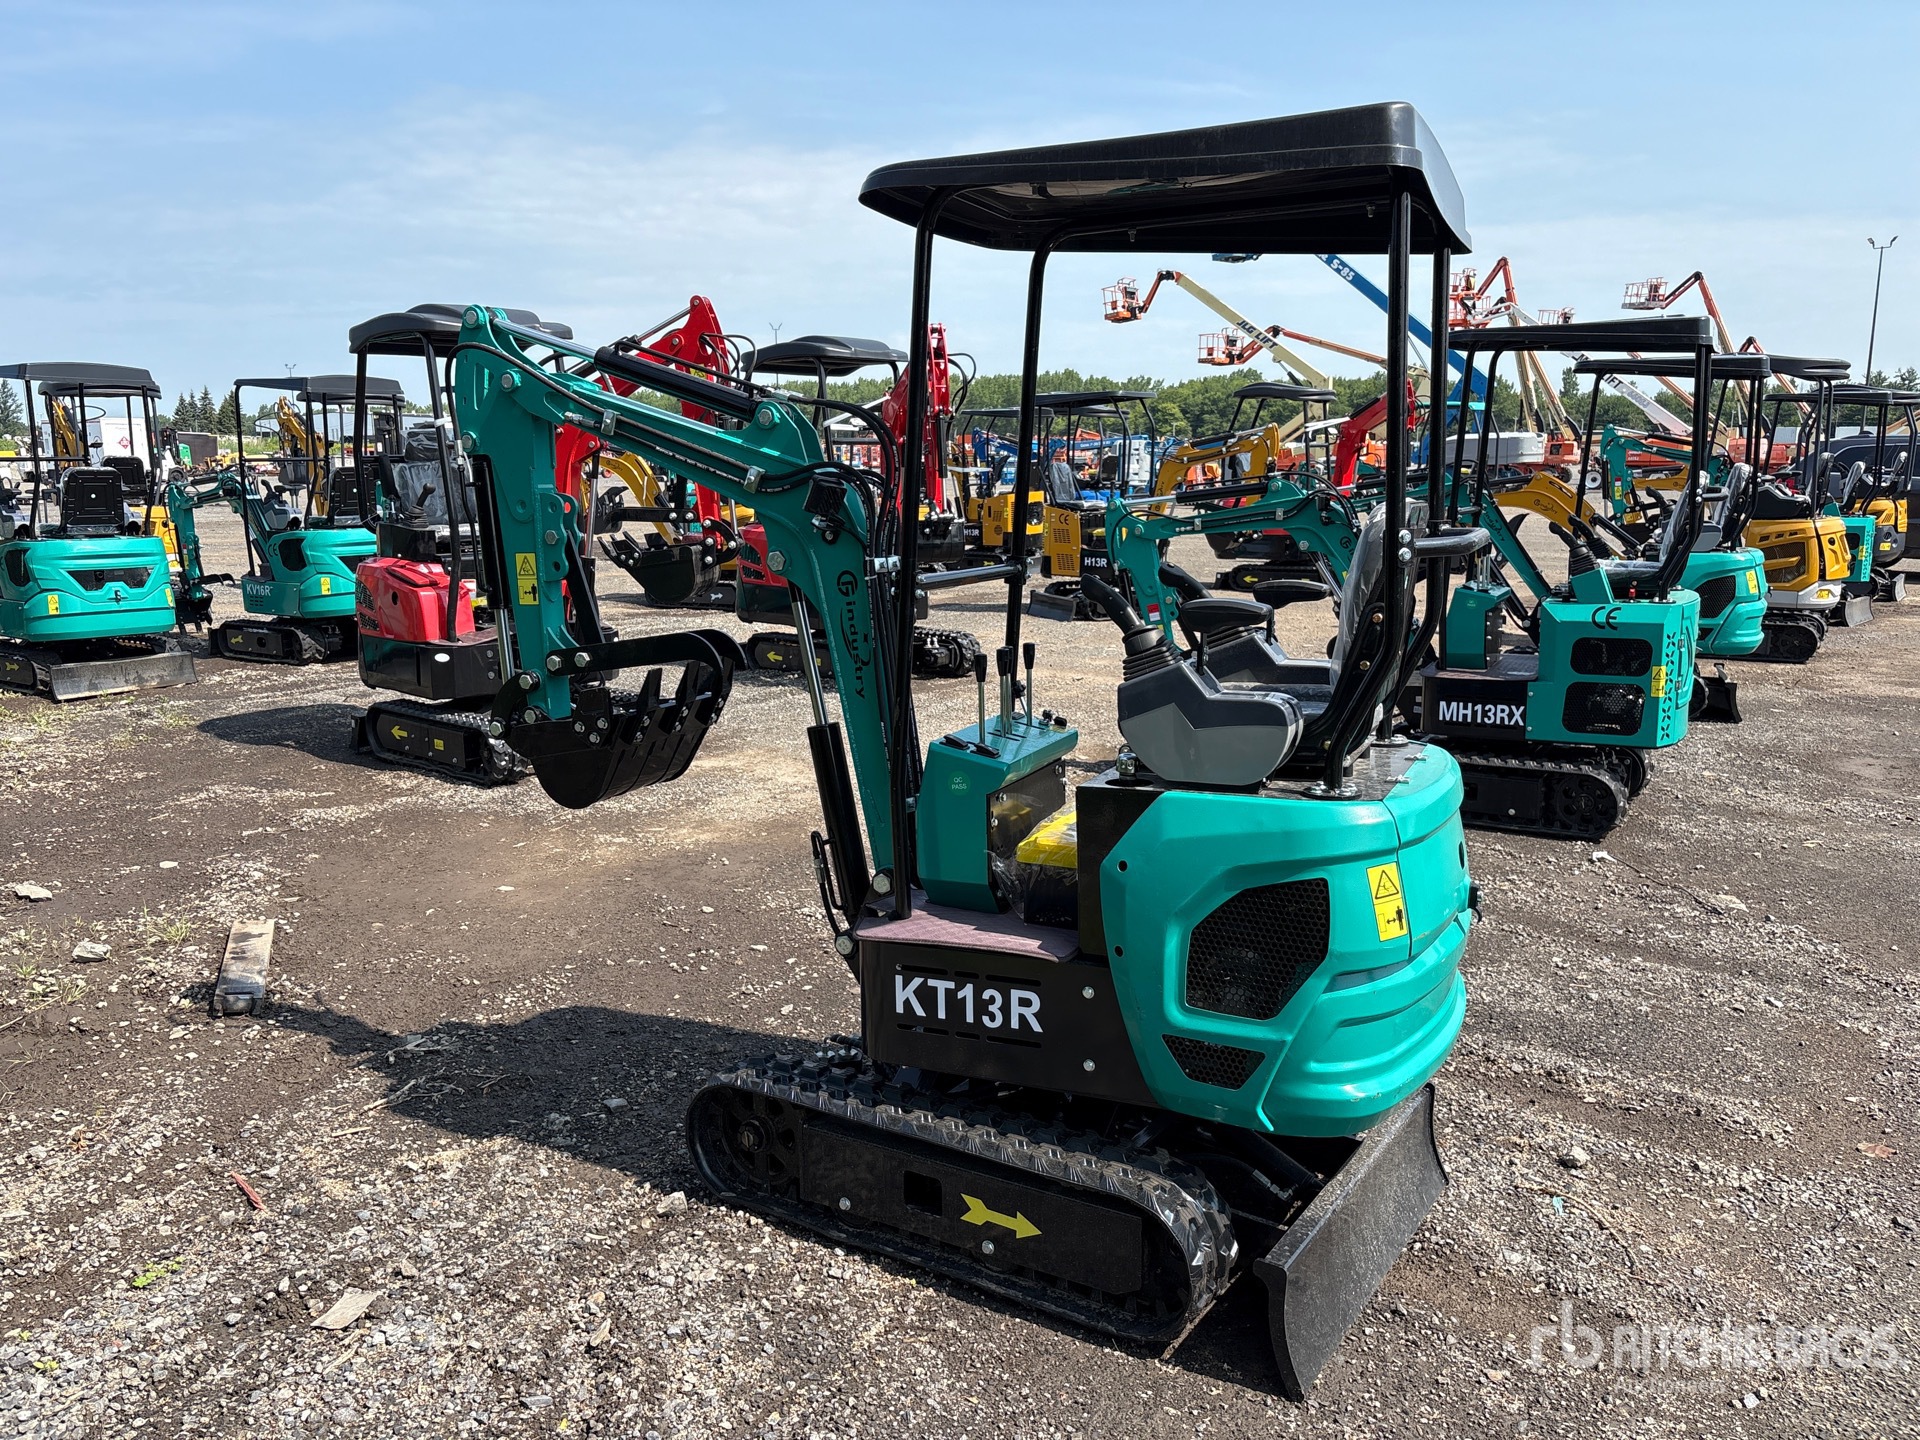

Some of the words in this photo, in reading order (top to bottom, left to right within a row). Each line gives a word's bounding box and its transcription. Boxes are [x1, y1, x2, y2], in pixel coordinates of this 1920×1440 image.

[1330, 259, 1355, 281] S-85
[1236, 320, 1257, 335] JLG
[1254, 332, 1278, 349] LIFT
[1058, 513, 1070, 526] CE
[963, 528, 980, 536] H13R
[1084, 556, 1108, 568] H13R
[246, 584, 272, 596] KV16R
[1591, 605, 1622, 631] CE
[1438, 700, 1526, 726] MH13RX
[894, 974, 1044, 1033] KT13R
